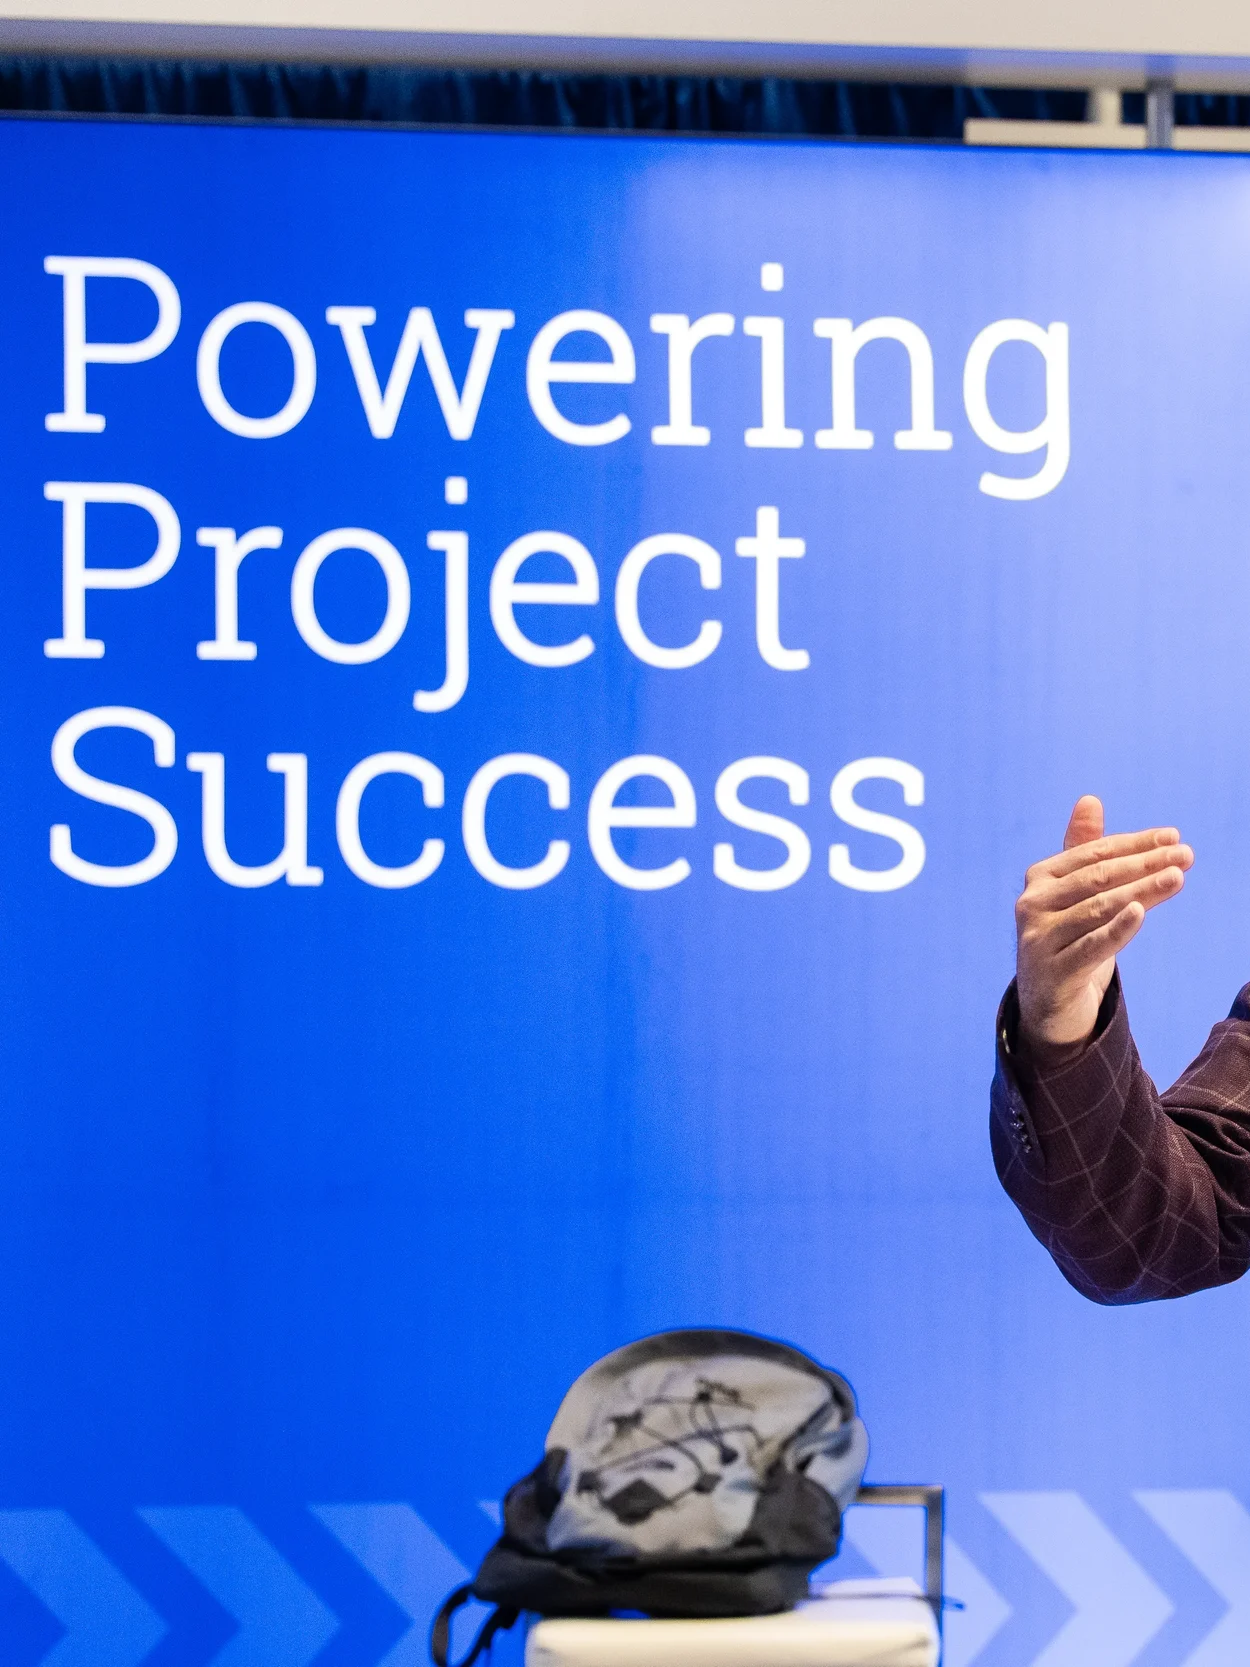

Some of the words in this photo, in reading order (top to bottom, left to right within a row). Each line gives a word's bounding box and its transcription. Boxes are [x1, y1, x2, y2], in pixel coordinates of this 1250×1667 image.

[44, 255, 1072, 502] Powering
[43, 475, 811, 713] Project
[50, 705, 928, 893] Success
